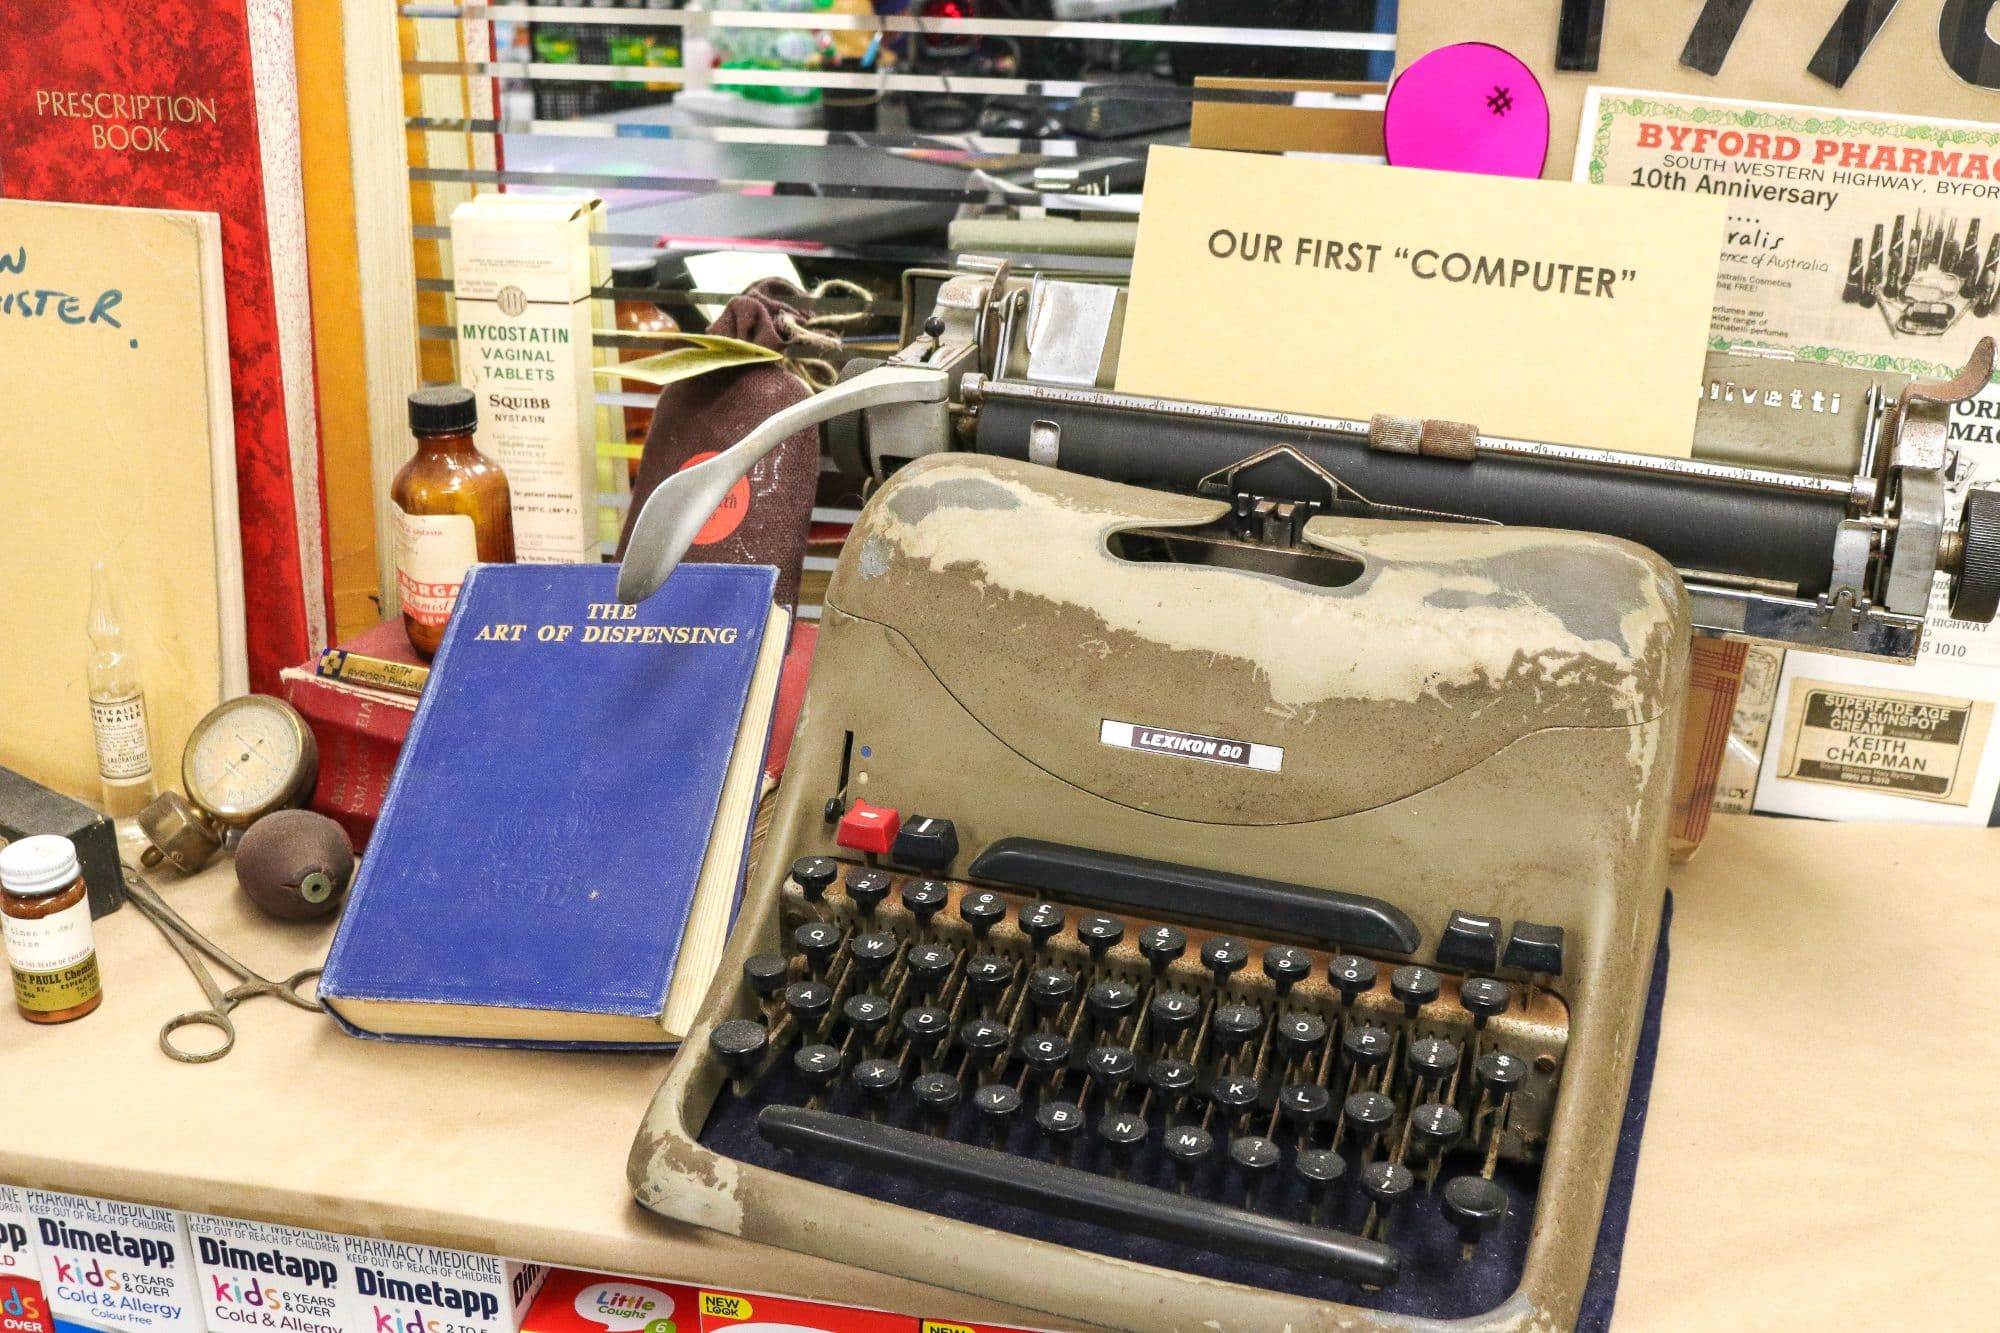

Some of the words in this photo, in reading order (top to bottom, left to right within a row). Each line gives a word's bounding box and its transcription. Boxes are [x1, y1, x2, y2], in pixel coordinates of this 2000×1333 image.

[36, 91, 217, 122] PRESCRIPTION
[92, 125, 170, 152] BOOK
[1637, 123, 1801, 161] BYFORD
[1663, 153, 1726, 173] SOUTH
[1734, 161, 1825, 183] WESTERN
[1631, 167, 1687, 192] 10th
[1695, 179, 1839, 211] Anniversary
[1208, 229, 1283, 263] OUR
[1296, 237, 1382, 273] FIRST
[1751, 253, 1766, 268] of
[1766, 255, 1829, 272] Australia
[1749, 276, 1792, 288] Cosmetics
[1748, 309, 1764, 317] and
[463, 325, 569, 343] MYCOSTATIN
[1750, 327, 1789, 338] perfumes
[481, 347, 555, 362] VAGINAL
[484, 366, 555, 381] TABLETS
[489, 394, 551, 410] SQUIBB
[1956, 399, 2000, 419] OR
[495, 413, 545, 424] NYSTATIN
[1948, 422, 2000, 444] MA
[587, 603, 637, 620] THE
[475, 625, 527, 641] ART
[537, 625, 573, 643] OF
[581, 626, 738, 644] DISPENSING
[1932, 617, 1989, 632] HIGHWAY
[1935, 643, 1967, 657] 1010
[384, 664, 412, 675] KEITH
[1824, 695, 1917, 716] SUPERFADE
[1918, 707, 1951, 722] AGE
[1830, 719, 1884, 736] CREAM
[1831, 708, 1865, 722] AND
[1868, 713, 1940, 731] SUNSPOT
[1140, 732, 1217, 755] LEXIKON
[1219, 746, 1243, 759] 80
[1848, 736, 1906, 753] KEITH
[1826, 747, 1927, 771] CHAPMAN
[29, 974, 61, 985] PAULL
[811, 930, 825, 941] Q
[867, 939, 884, 950] W
[925, 952, 939, 962] E
[983, 963, 997, 974] R
[1048, 976, 1060, 986] T
[1108, 990, 1121, 999] Y
[1168, 1001, 1182, 1011] U
[1362, 1035, 1376, 1045] P
[800, 990, 813, 1000] A
[860, 1003, 873, 1013] S
[918, 1014, 933, 1024] D
[977, 1028, 992, 1038] F
[1039, 1042, 1053, 1052] G
[1103, 1053, 1118, 1065] H
[1167, 1069, 1180, 1078] J
[1229, 1083, 1244, 1095] K
[1297, 1092, 1310, 1103] L
[810, 1053, 826, 1064] Z
[870, 1067, 884, 1078] X
[930, 1083, 944, 1092] C
[992, 1094, 1005, 1104] V
[1053, 1111, 1068, 1121] B
[1116, 1122, 1132, 1133] N
[1179, 1134, 1198, 1147] M
[29, 1203, 51, 1215] KEEP
[53, 1206, 71, 1218] OUT
[73, 1209, 86, 1220] OF
[87, 1212, 116, 1226] REACH
[118, 1217, 131, 1228] OF
[132, 1219, 176, 1233] CHILDREN
[38, 1217, 175, 1268] Dimetapp
[191, 1223, 212, 1232] KEEP
[214, 1226, 234, 1236] OUT
[235, 1230, 246, 1239] OF
[250, 1231, 278, 1244] REACH
[282, 1236, 294, 1246] OF
[295, 1238, 340, 1253] CHILDREN
[198, 1236, 338, 1289] Dimetapp
[344, 1237, 423, 1263] PHARMACY
[428, 1249, 501, 1275] MEDICINE
[54, 1255, 121, 1291] kids
[123, 1273, 130, 1282] 6
[132, 1274, 175, 1288] YEARS
[346, 1252, 368, 1265] KEEP
[371, 1257, 389, 1268] OUT
[393, 1260, 405, 1270] OF
[407, 1262, 438, 1275] REACH
[440, 1267, 453, 1278] OF
[455, 1269, 501, 1284] CHILDREN
[124, 1283, 134, 1293] &
[135, 1285, 170, 1297] OVER
[212, 1274, 281, 1310] kids
[283, 1291, 291, 1301] 6
[293, 1293, 336, 1308] YEARS
[355, 1266, 499, 1320] Dimetapp
[57, 1286, 97, 1305] Cold
[103, 1294, 116, 1308] &
[120, 1298, 182, 1320] Allergy
[285, 1303, 294, 1312] &
[296, 1304, 331, 1317] OVER
[596, 1291, 656, 1311] Little
[705, 1295, 739, 1308] NEW
[91, 1307, 127, 1321] Colour
[129, 1313, 153, 1325] Free
[215, 1305, 258, 1325] Cold
[262, 1312, 277, 1328] &
[598, 1305, 647, 1319] Coughs
[706, 1306, 739, 1317] LOOK
[4, 1318, 43, 1333] OVER
